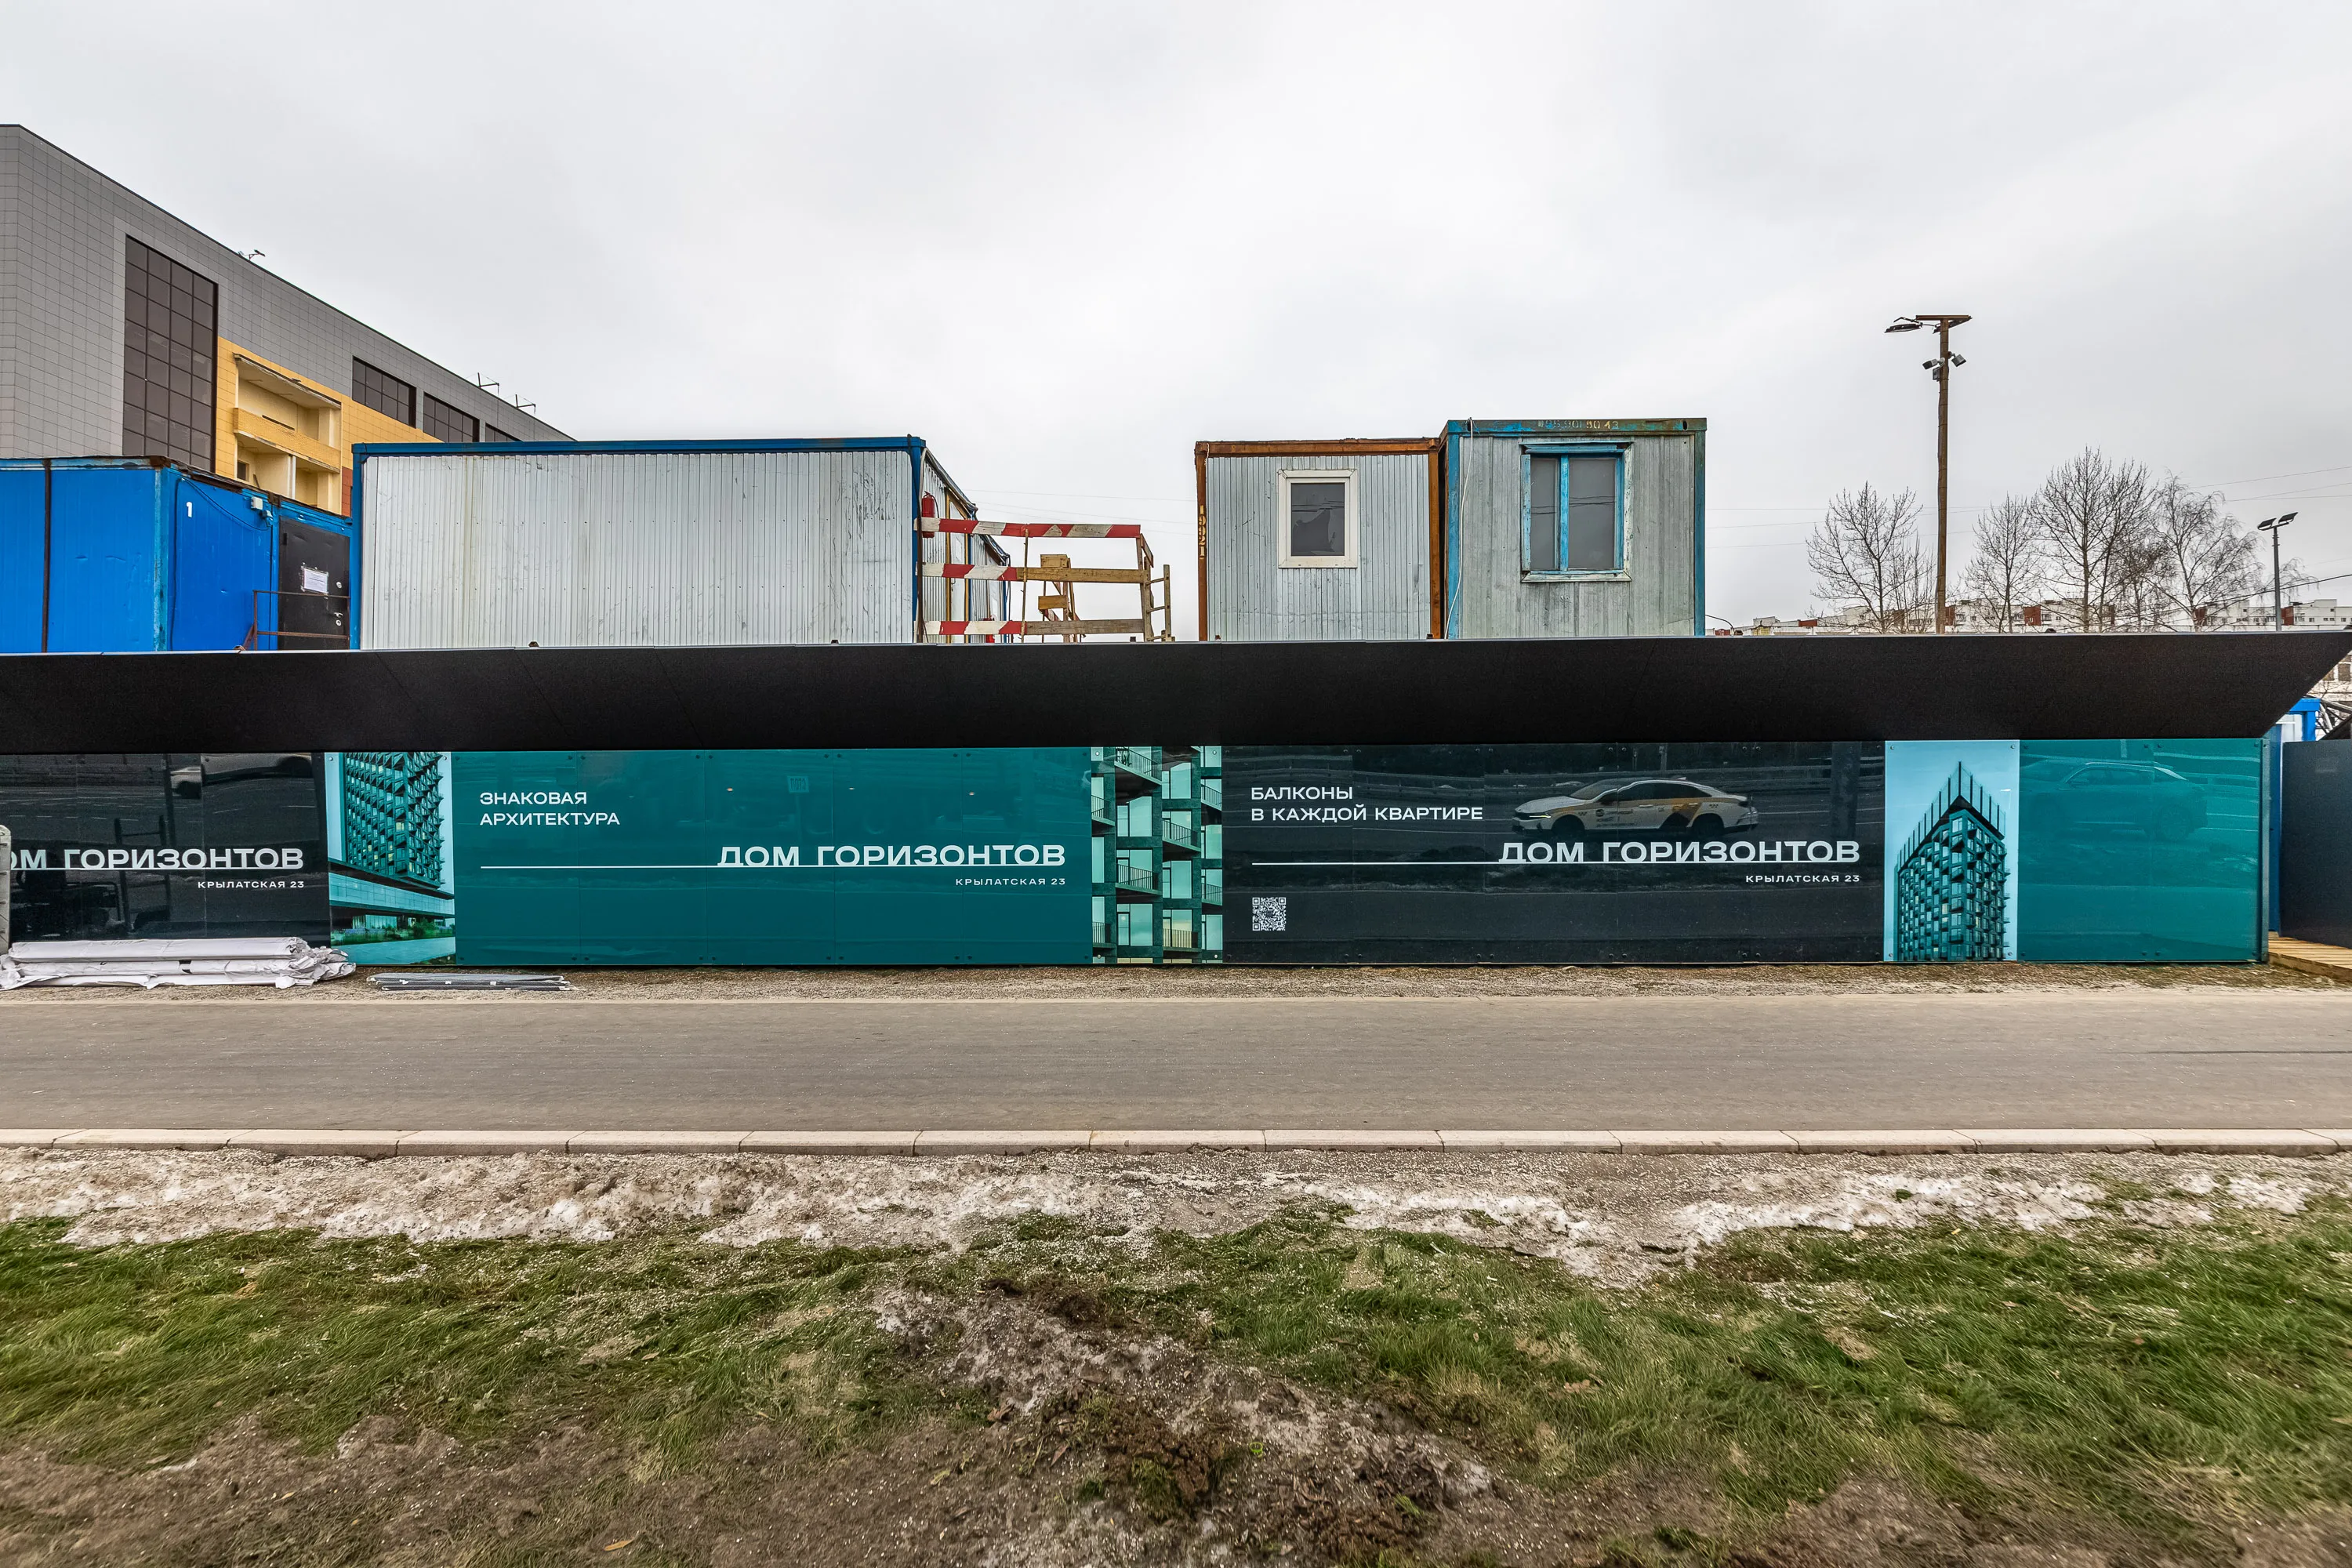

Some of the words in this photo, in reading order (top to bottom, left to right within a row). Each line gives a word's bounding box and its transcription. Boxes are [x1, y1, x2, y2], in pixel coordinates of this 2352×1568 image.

[186, 501, 193, 517] 1
[480, 791, 588, 806] ЗНАКОВАЯ
[1251, 786, 1353, 800] БАЛКОНЫ
[480, 812, 621, 826] АРХИТЕКТУРА
[1251, 808, 1265, 822] В
[1272, 804, 1367, 824] КАЖДОЙ
[1374, 807, 1483, 821] КВАРТИРЕ
[64, 848, 304, 869] ГОРИЗОНТОВ
[717, 847, 800, 866] ДОМ
[818, 844, 1065, 866] ГОРИЗОНТОВ
[1498, 842, 1584, 863] ДОМ
[1602, 840, 1860, 863] ГОРИЗОНТОВ
[198, 880, 286, 889] КРЫЛАТСКАЯ
